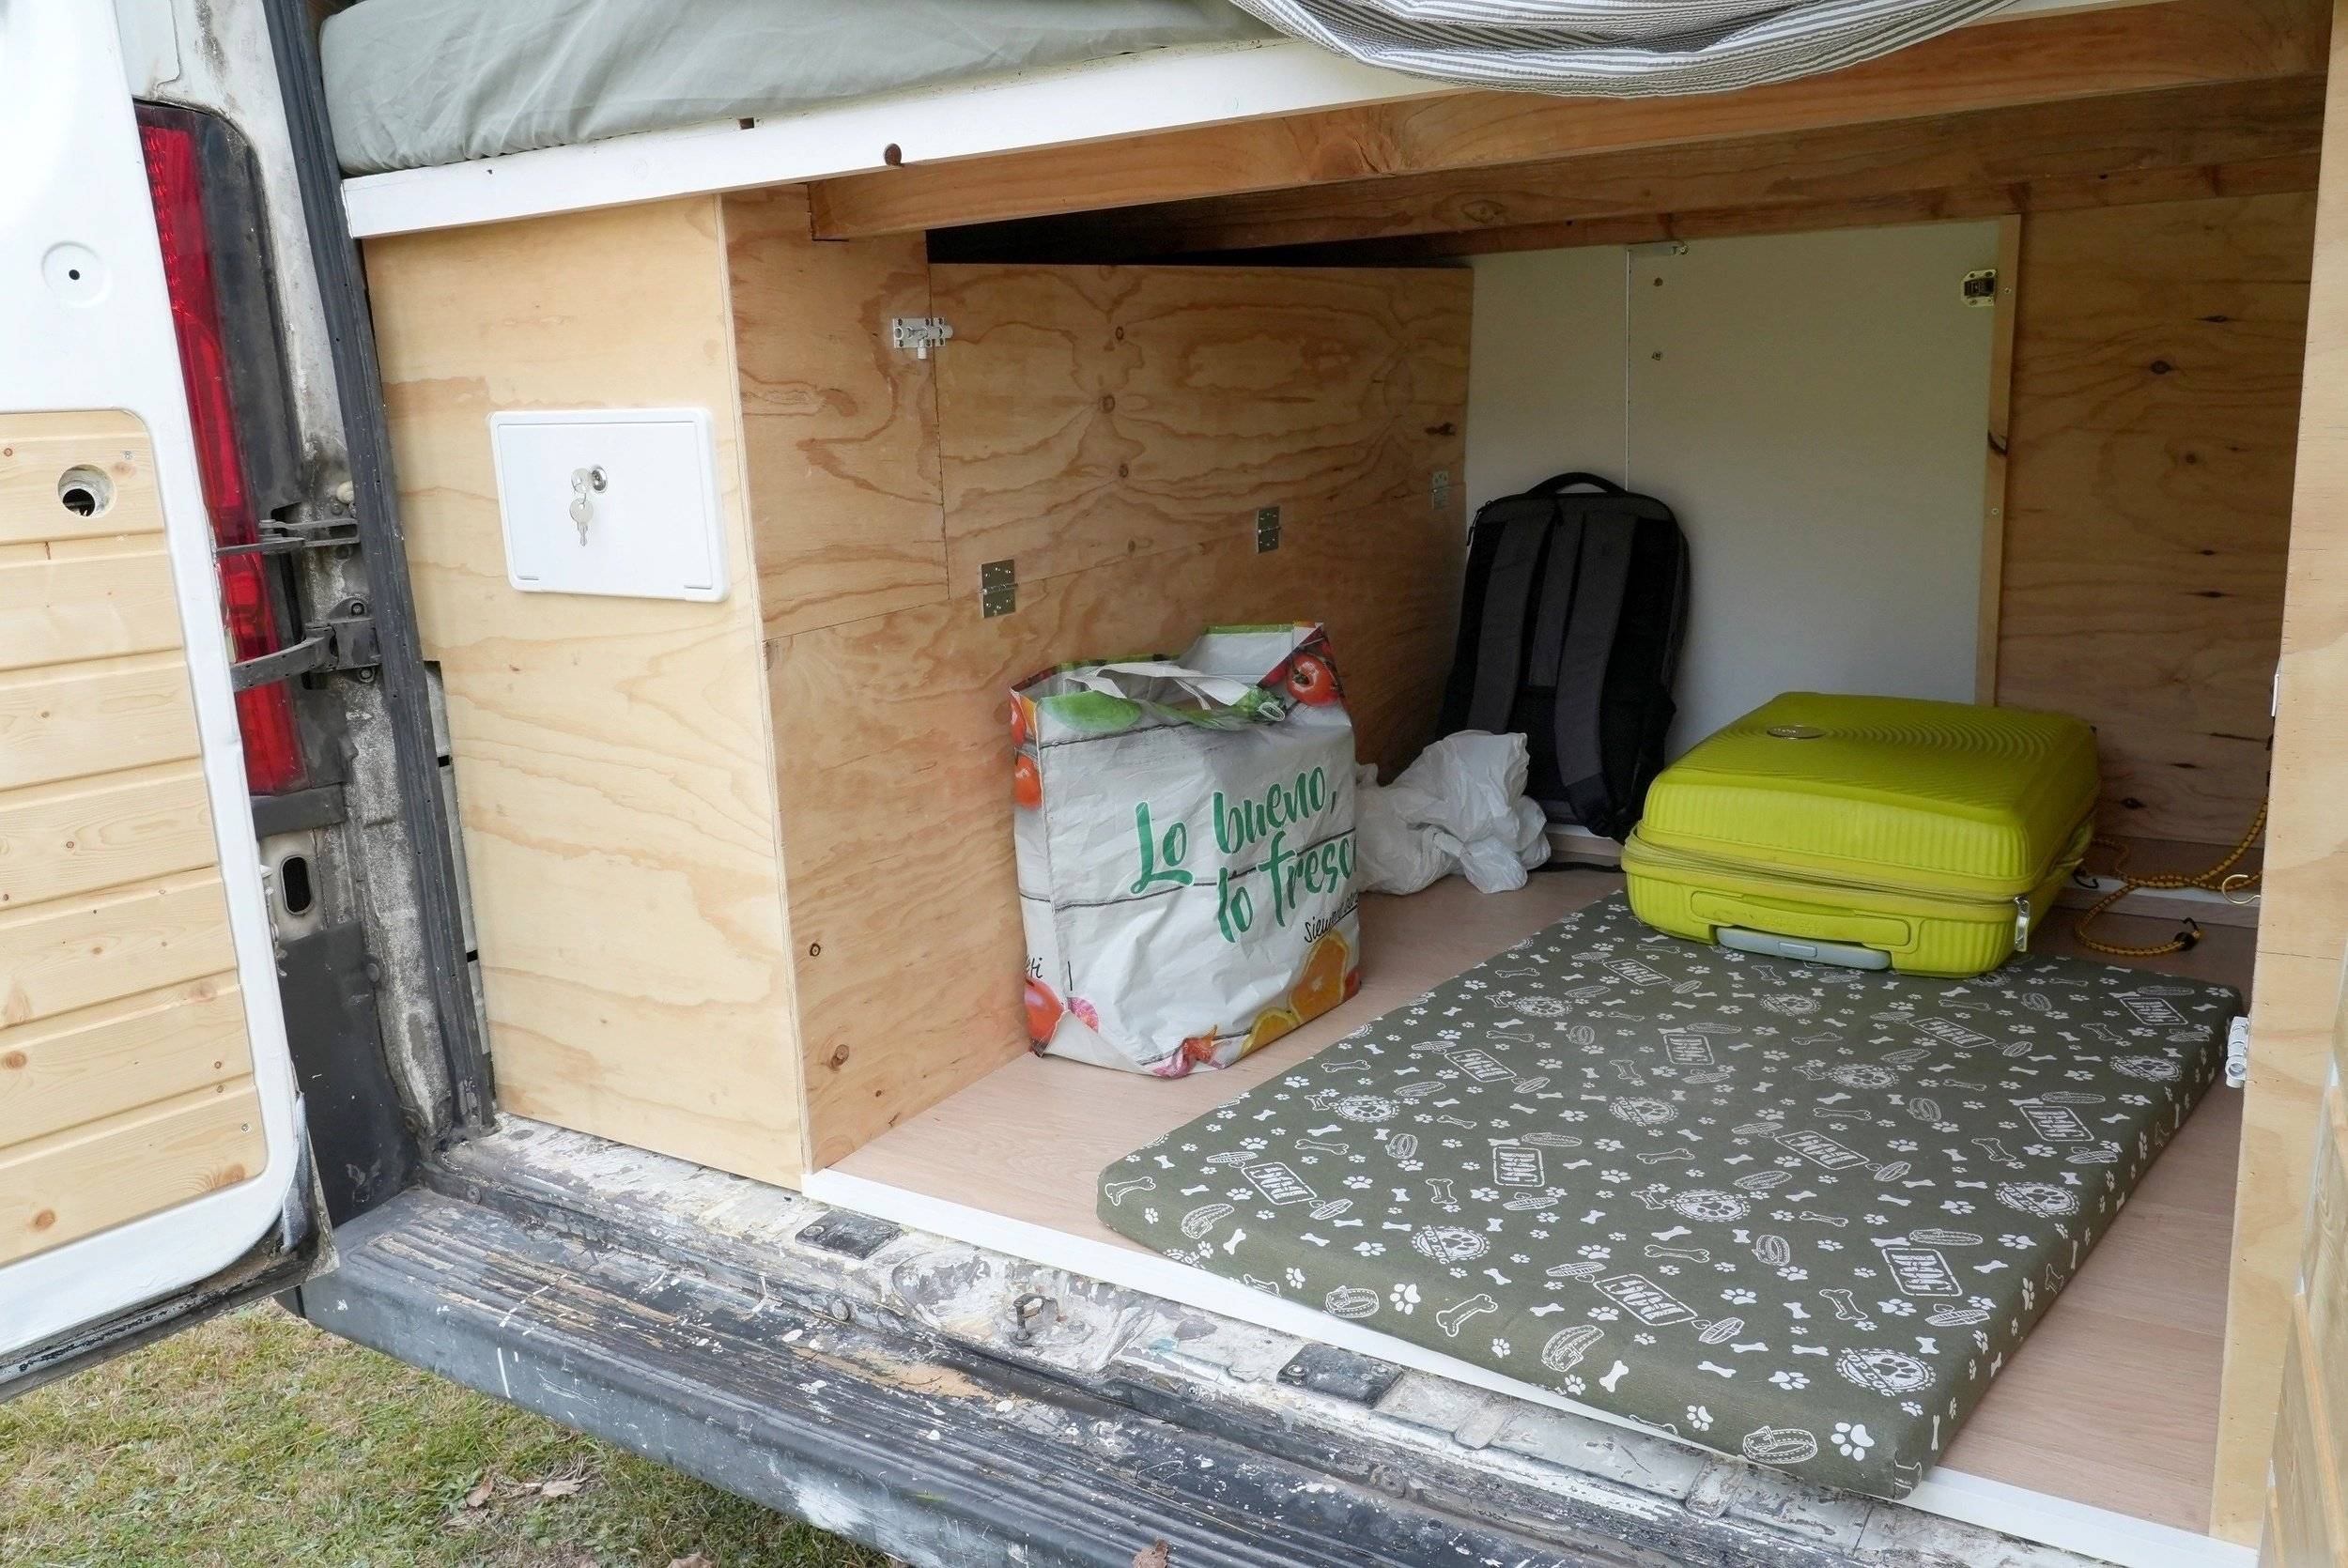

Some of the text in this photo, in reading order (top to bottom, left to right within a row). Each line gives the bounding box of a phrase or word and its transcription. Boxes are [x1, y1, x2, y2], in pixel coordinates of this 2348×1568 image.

[1130, 765, 1337, 895] Lo bueno,
[1215, 866, 1255, 943] lo
[1249, 1166, 1308, 1199] DOG
[1421, 1224, 1450, 1265] TOP DOG
[1891, 1253, 1953, 1291] DOG
[1603, 1279, 1685, 1320] DOG
[1840, 1347, 1896, 1397] TOP DOG
